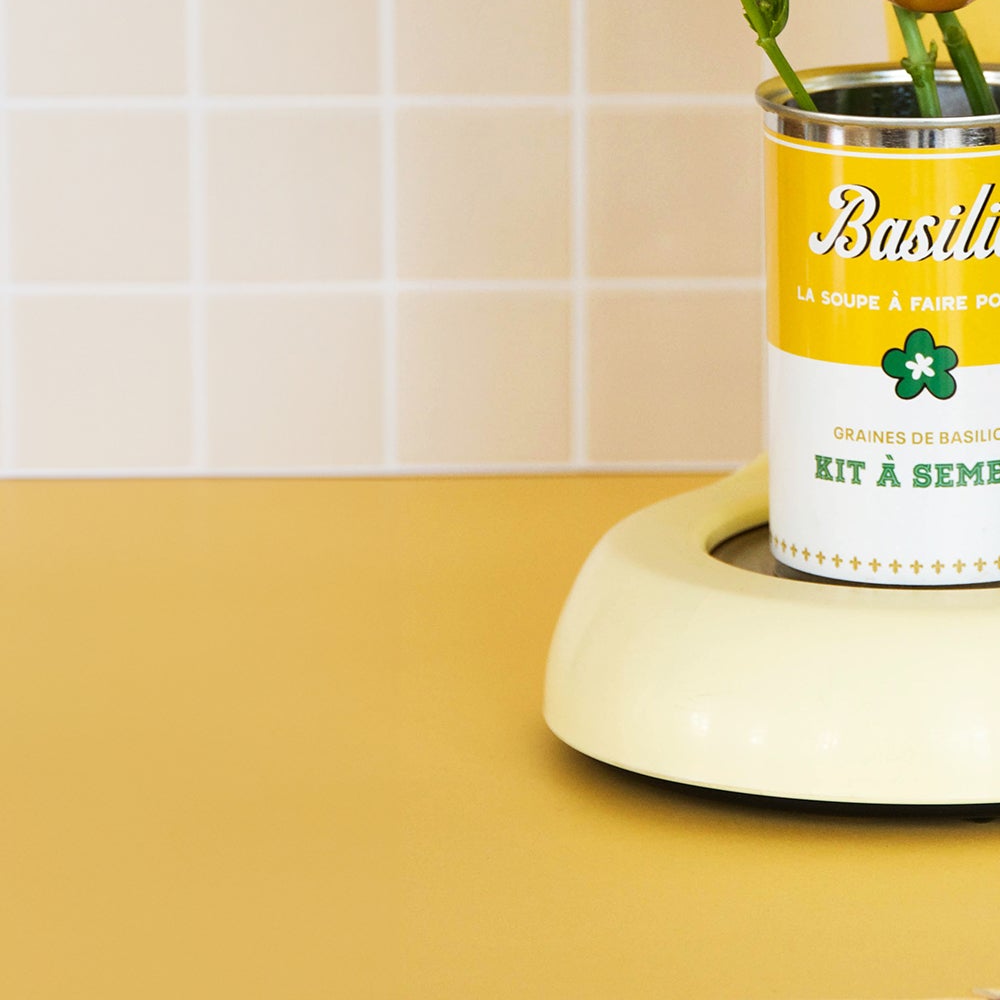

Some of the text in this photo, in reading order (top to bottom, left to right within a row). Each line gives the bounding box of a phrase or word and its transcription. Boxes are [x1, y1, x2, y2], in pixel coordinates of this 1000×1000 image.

[797, 286, 815, 303] LA
[821, 290, 880, 310] SOUPE
[888, 291, 902, 311] À
[910, 296, 968, 311] FAIRE
[833, 426, 906, 445] GRAINES
[911, 432, 934, 445] DE
[814, 454, 865, 485] KIT
[876, 454, 901, 488] À
